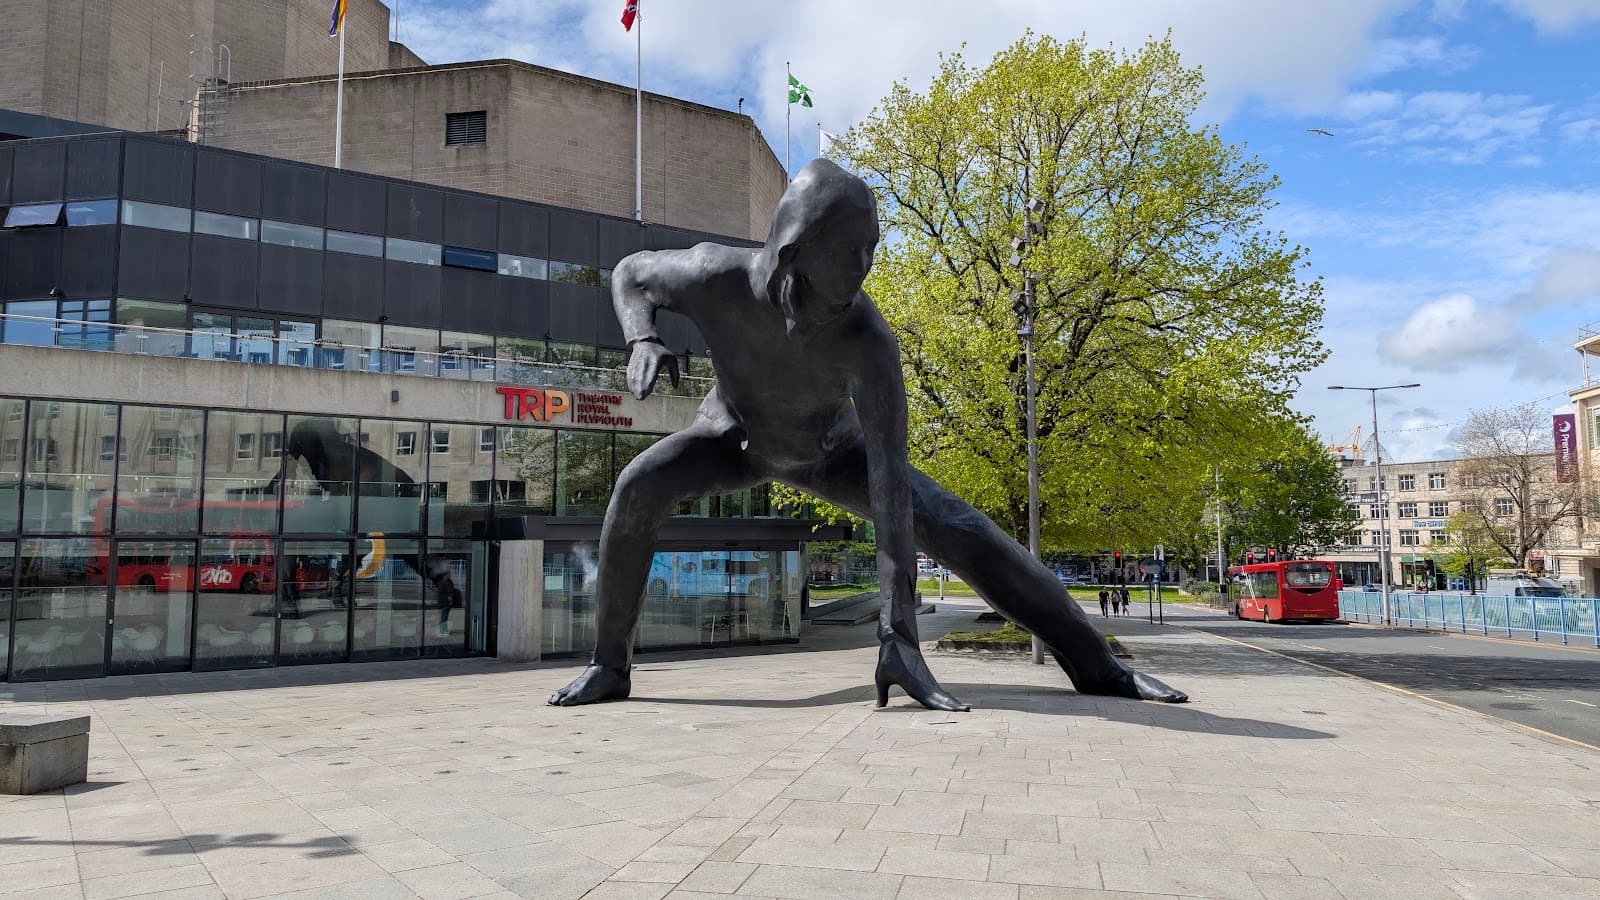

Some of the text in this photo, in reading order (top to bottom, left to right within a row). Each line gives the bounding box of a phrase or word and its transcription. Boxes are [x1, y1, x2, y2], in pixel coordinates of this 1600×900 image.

[496, 386, 569, 422] TRP
[577, 392, 623, 405] THEATRE
[577, 403, 611, 415] ROYAL
[577, 414, 633, 427] PLYMOUTH
[1560, 434, 1571, 462] Premier
